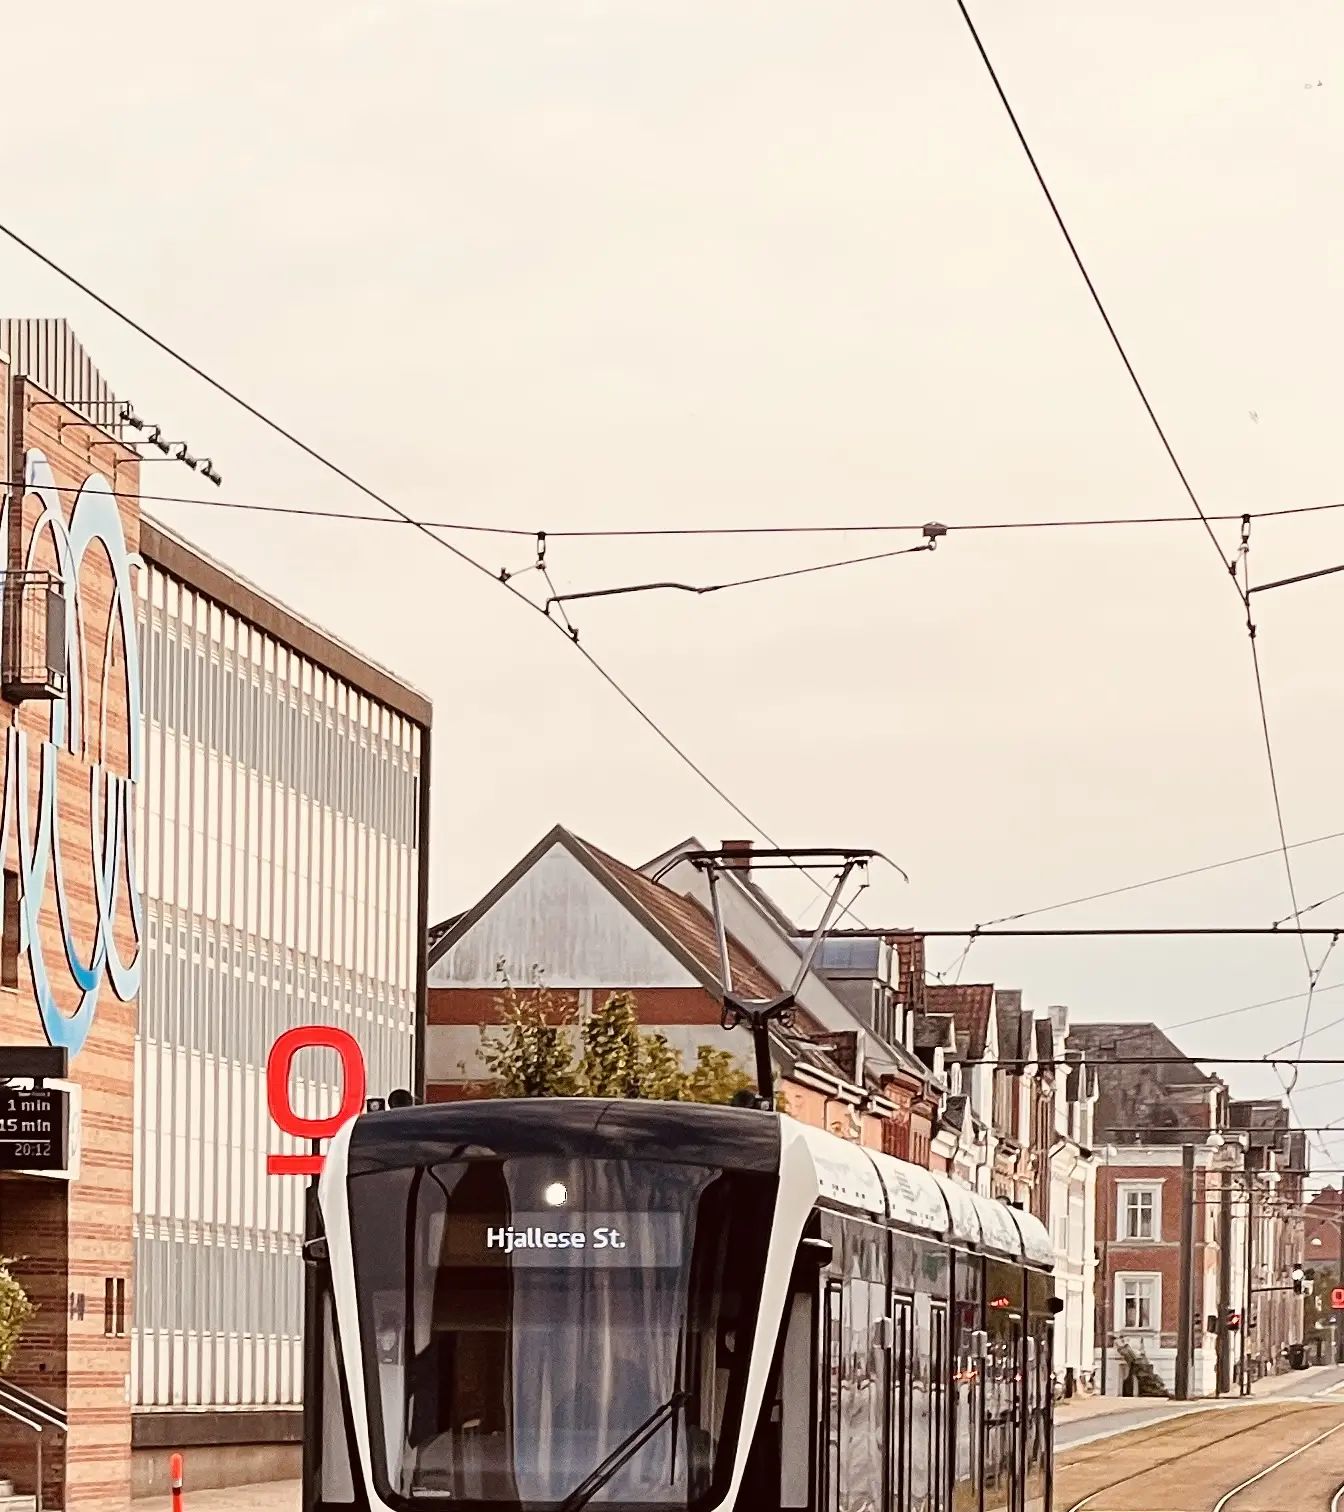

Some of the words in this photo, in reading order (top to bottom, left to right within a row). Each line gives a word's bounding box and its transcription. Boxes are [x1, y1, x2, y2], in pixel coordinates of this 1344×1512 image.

[7, 1099, 17, 1112] 1
[21, 1099, 51, 1112] min
[21, 1118, 51, 1132] min
[14, 1143, 51, 1156] 20:12
[486, 1226, 586, 1254] Hjallese
[593, 1227, 626, 1249] St.
